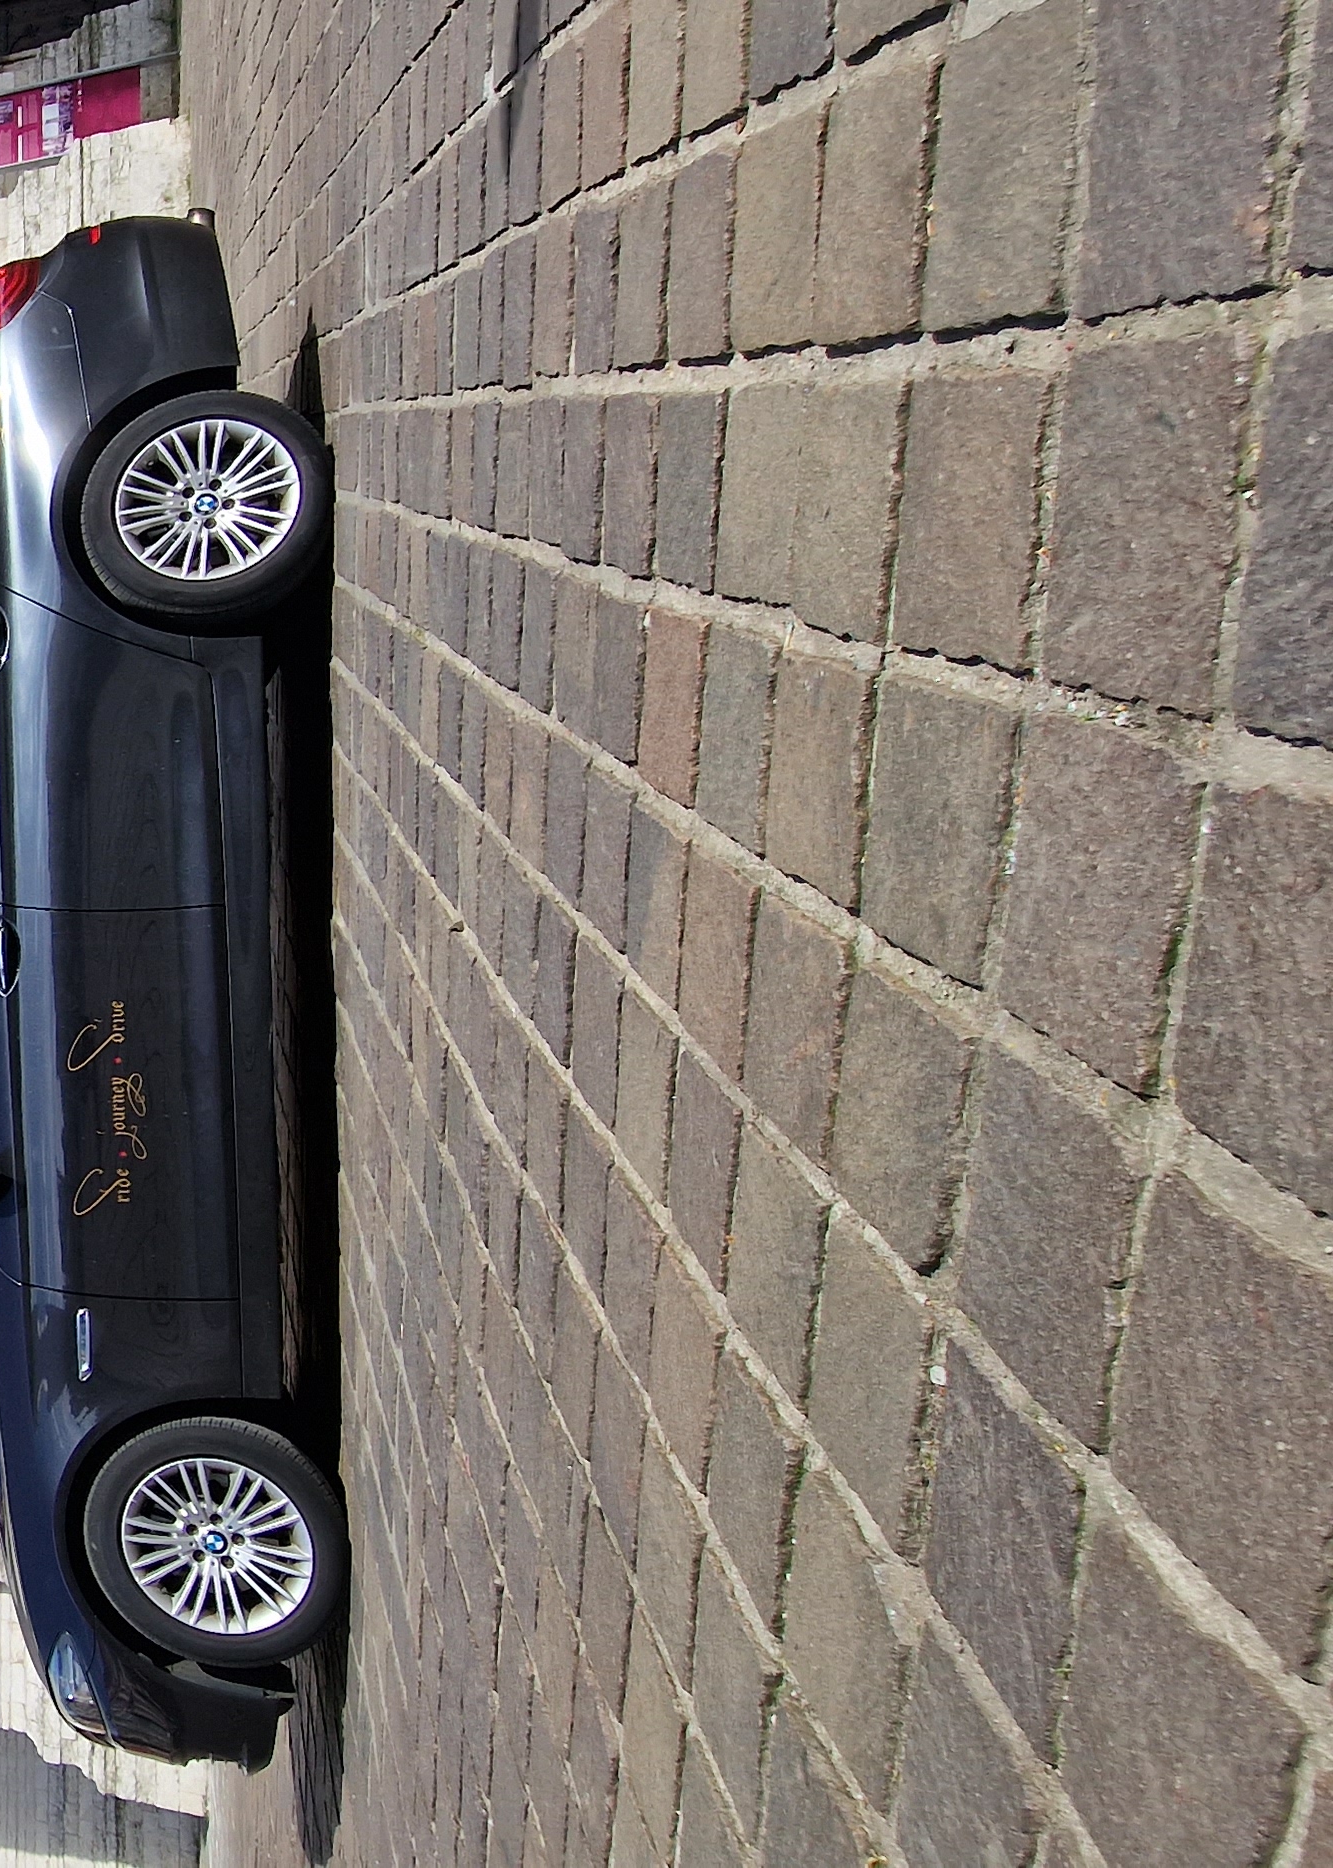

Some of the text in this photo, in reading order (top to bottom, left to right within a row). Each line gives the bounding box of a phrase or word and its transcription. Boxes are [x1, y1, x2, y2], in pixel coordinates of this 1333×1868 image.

[67, 999, 148, 1217] ride journey drive
